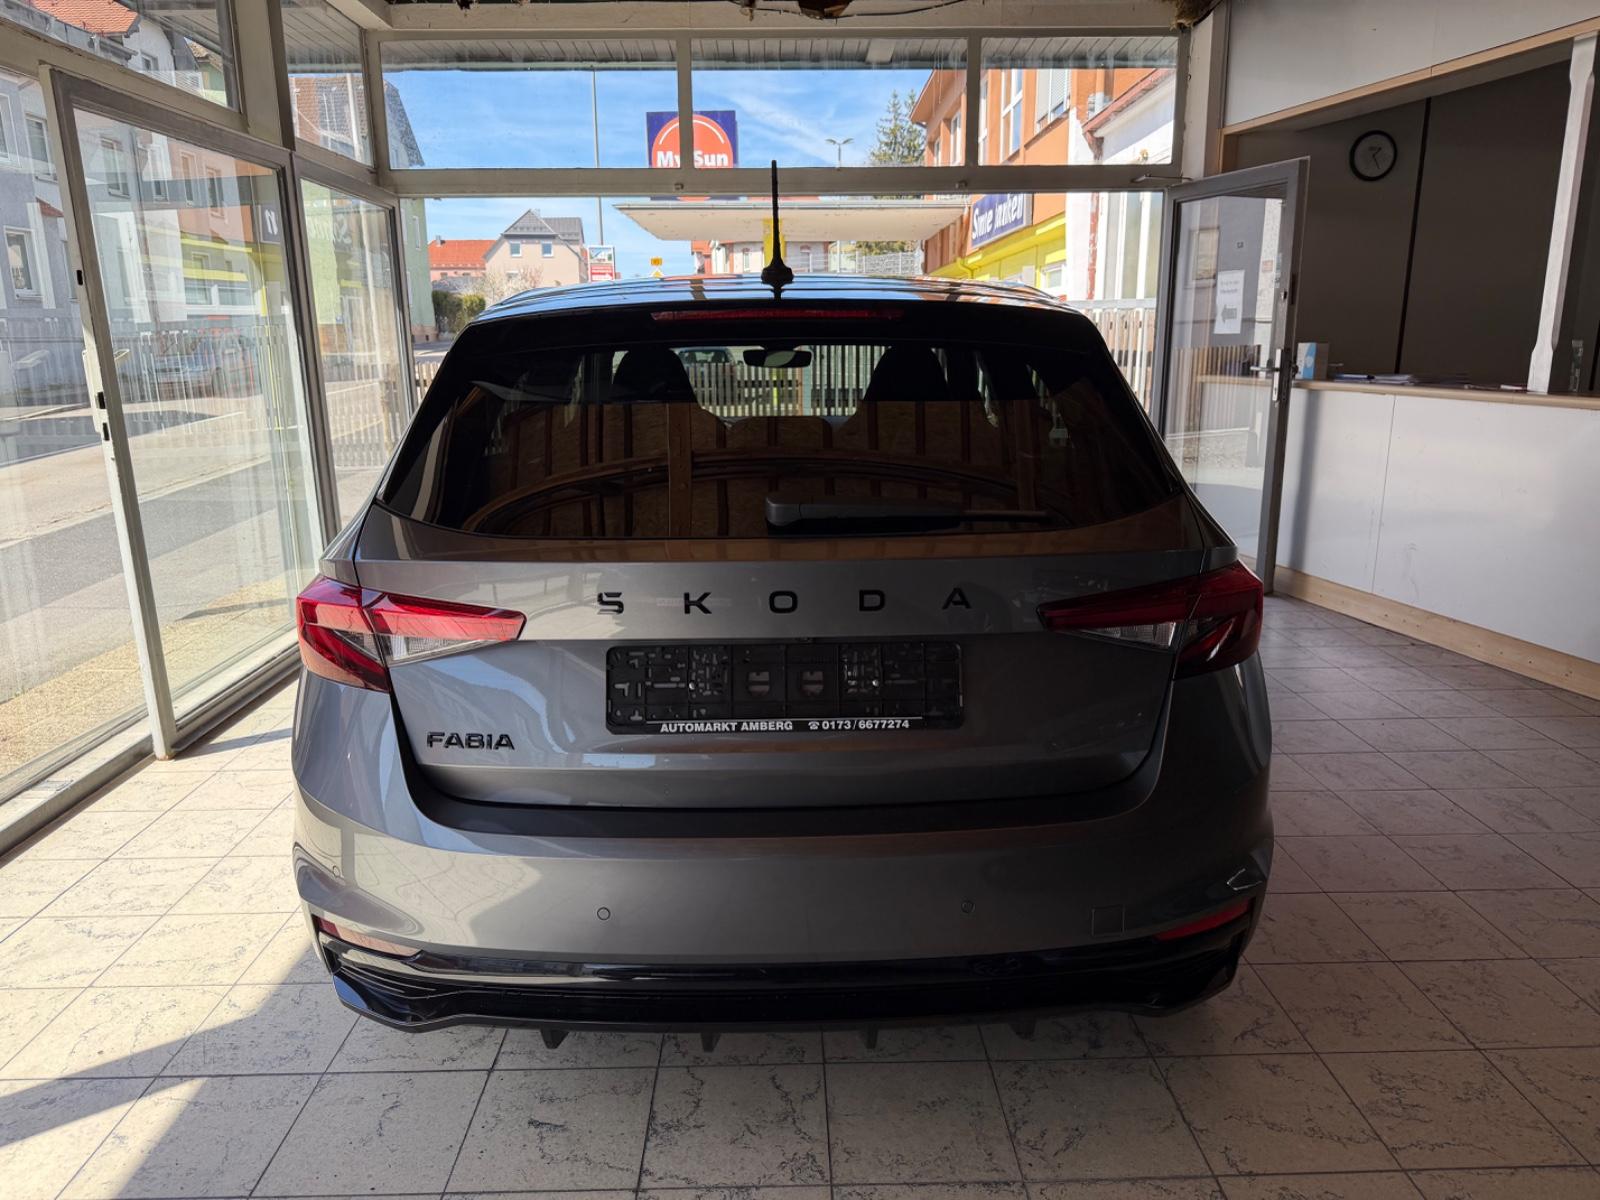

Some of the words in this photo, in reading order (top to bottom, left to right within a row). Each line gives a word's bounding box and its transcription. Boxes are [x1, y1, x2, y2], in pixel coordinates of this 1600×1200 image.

[693, 149, 728, 168] Sun
[660, 721, 738, 733] AUTOMARKT
[740, 720, 793, 732] AMBERG
[426, 731, 515, 750] FABIA
